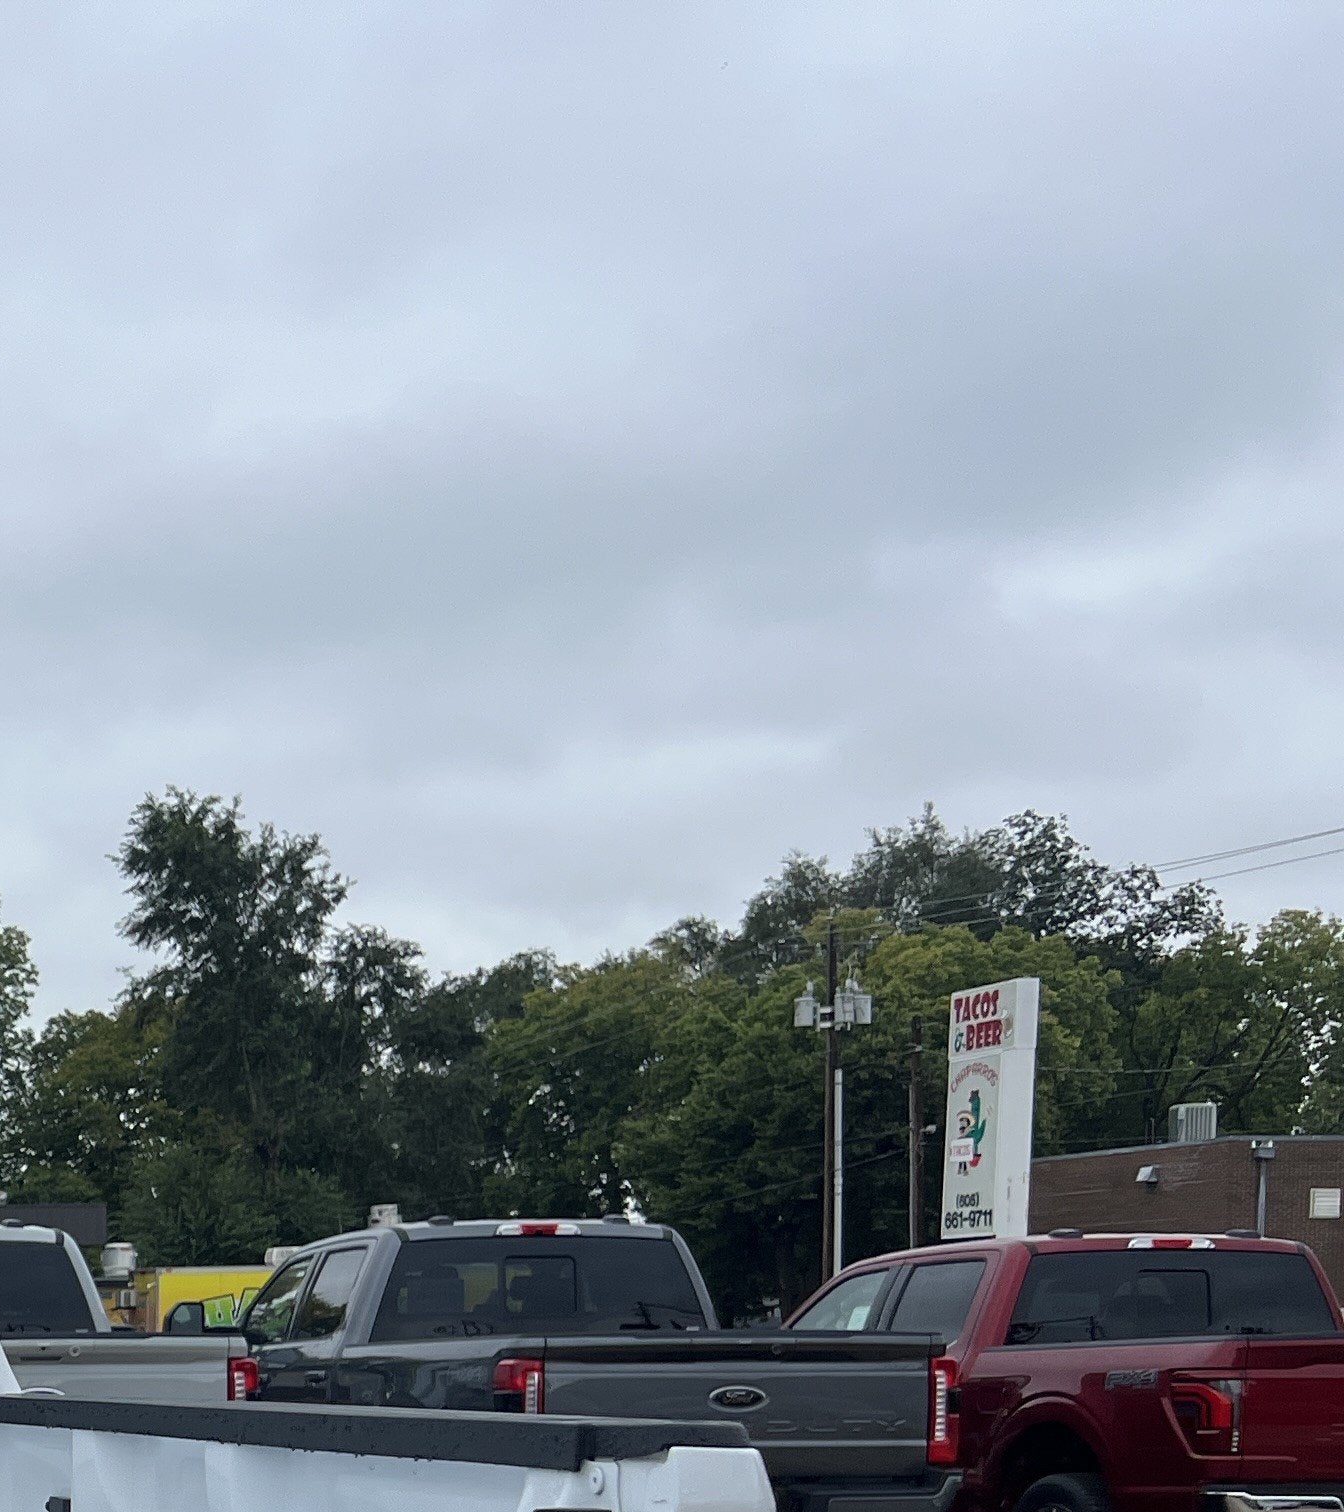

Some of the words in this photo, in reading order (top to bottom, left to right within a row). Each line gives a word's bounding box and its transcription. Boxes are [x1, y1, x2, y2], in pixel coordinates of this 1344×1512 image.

[954, 989, 999, 1024] TACOS
[966, 1019, 1003, 1051] BEER
[944, 1209, 993, 1229] 661-9711
